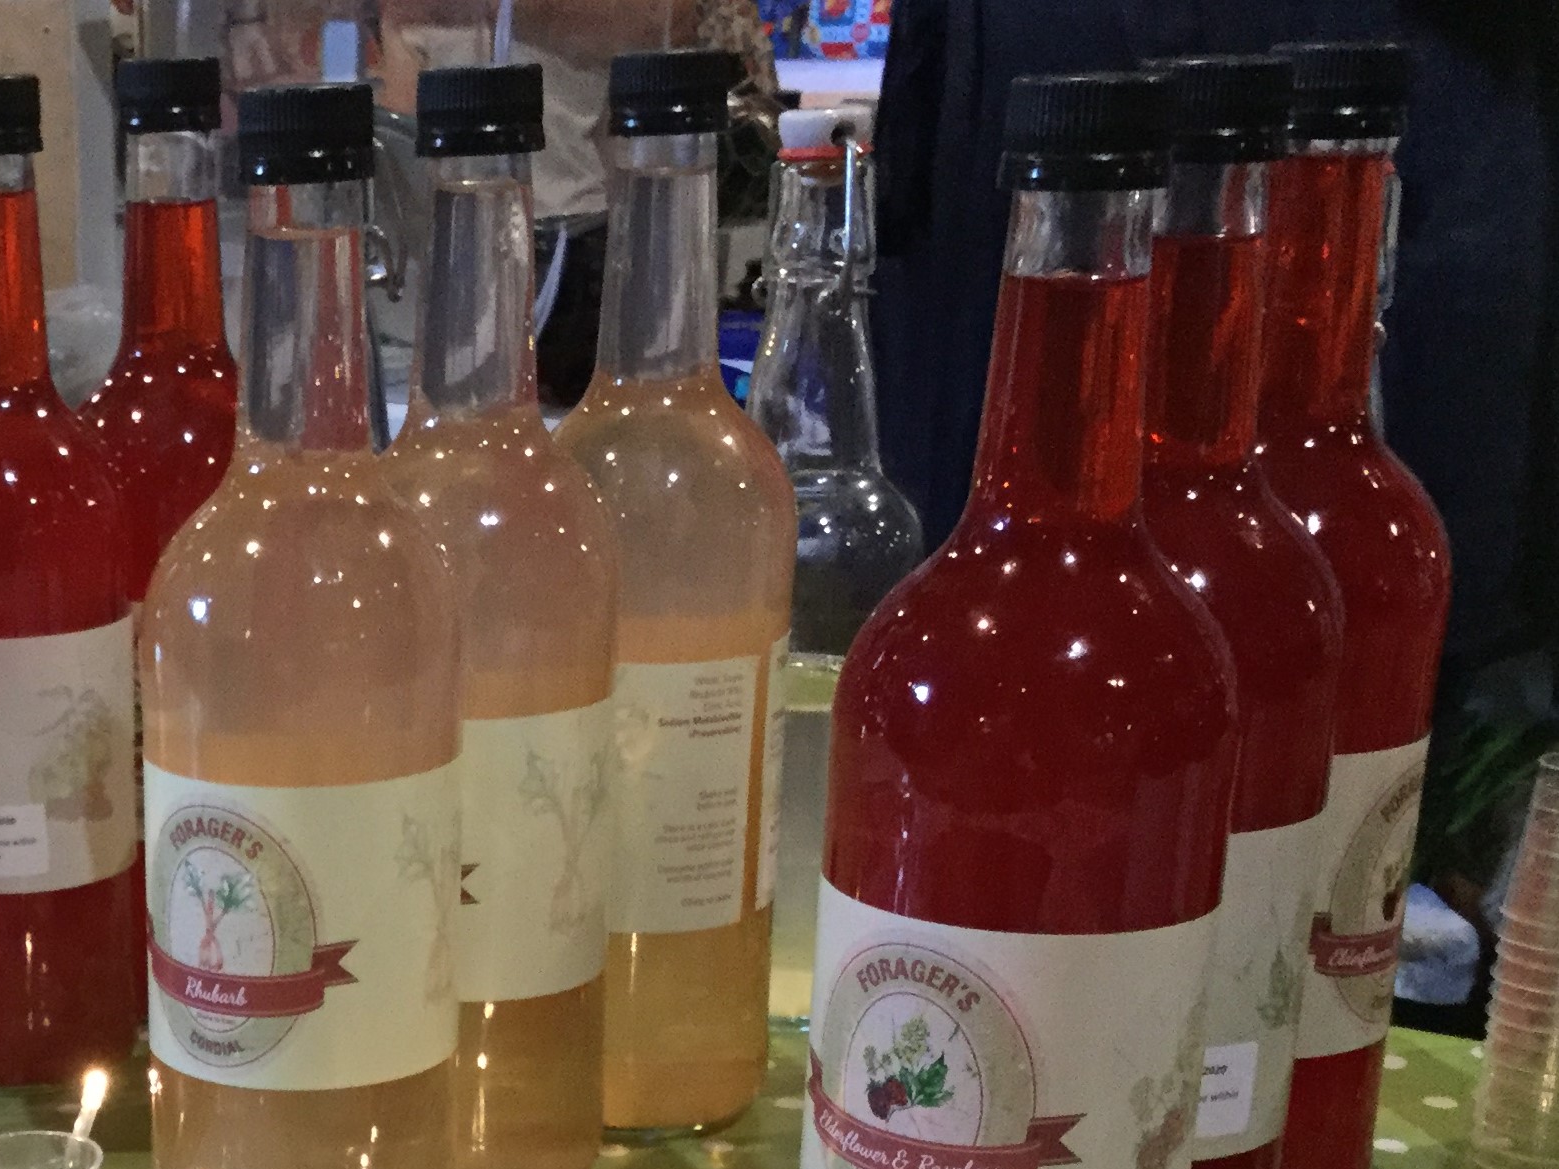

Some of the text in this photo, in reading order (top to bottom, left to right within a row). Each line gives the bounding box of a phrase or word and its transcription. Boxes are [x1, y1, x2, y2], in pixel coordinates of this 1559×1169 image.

[169, 816, 264, 860] FORAGER'S
[184, 975, 248, 1007] Rhubarb
[856, 956, 982, 1014] FORAGER'S
[819, 1108, 890, 1166] Elderflower
